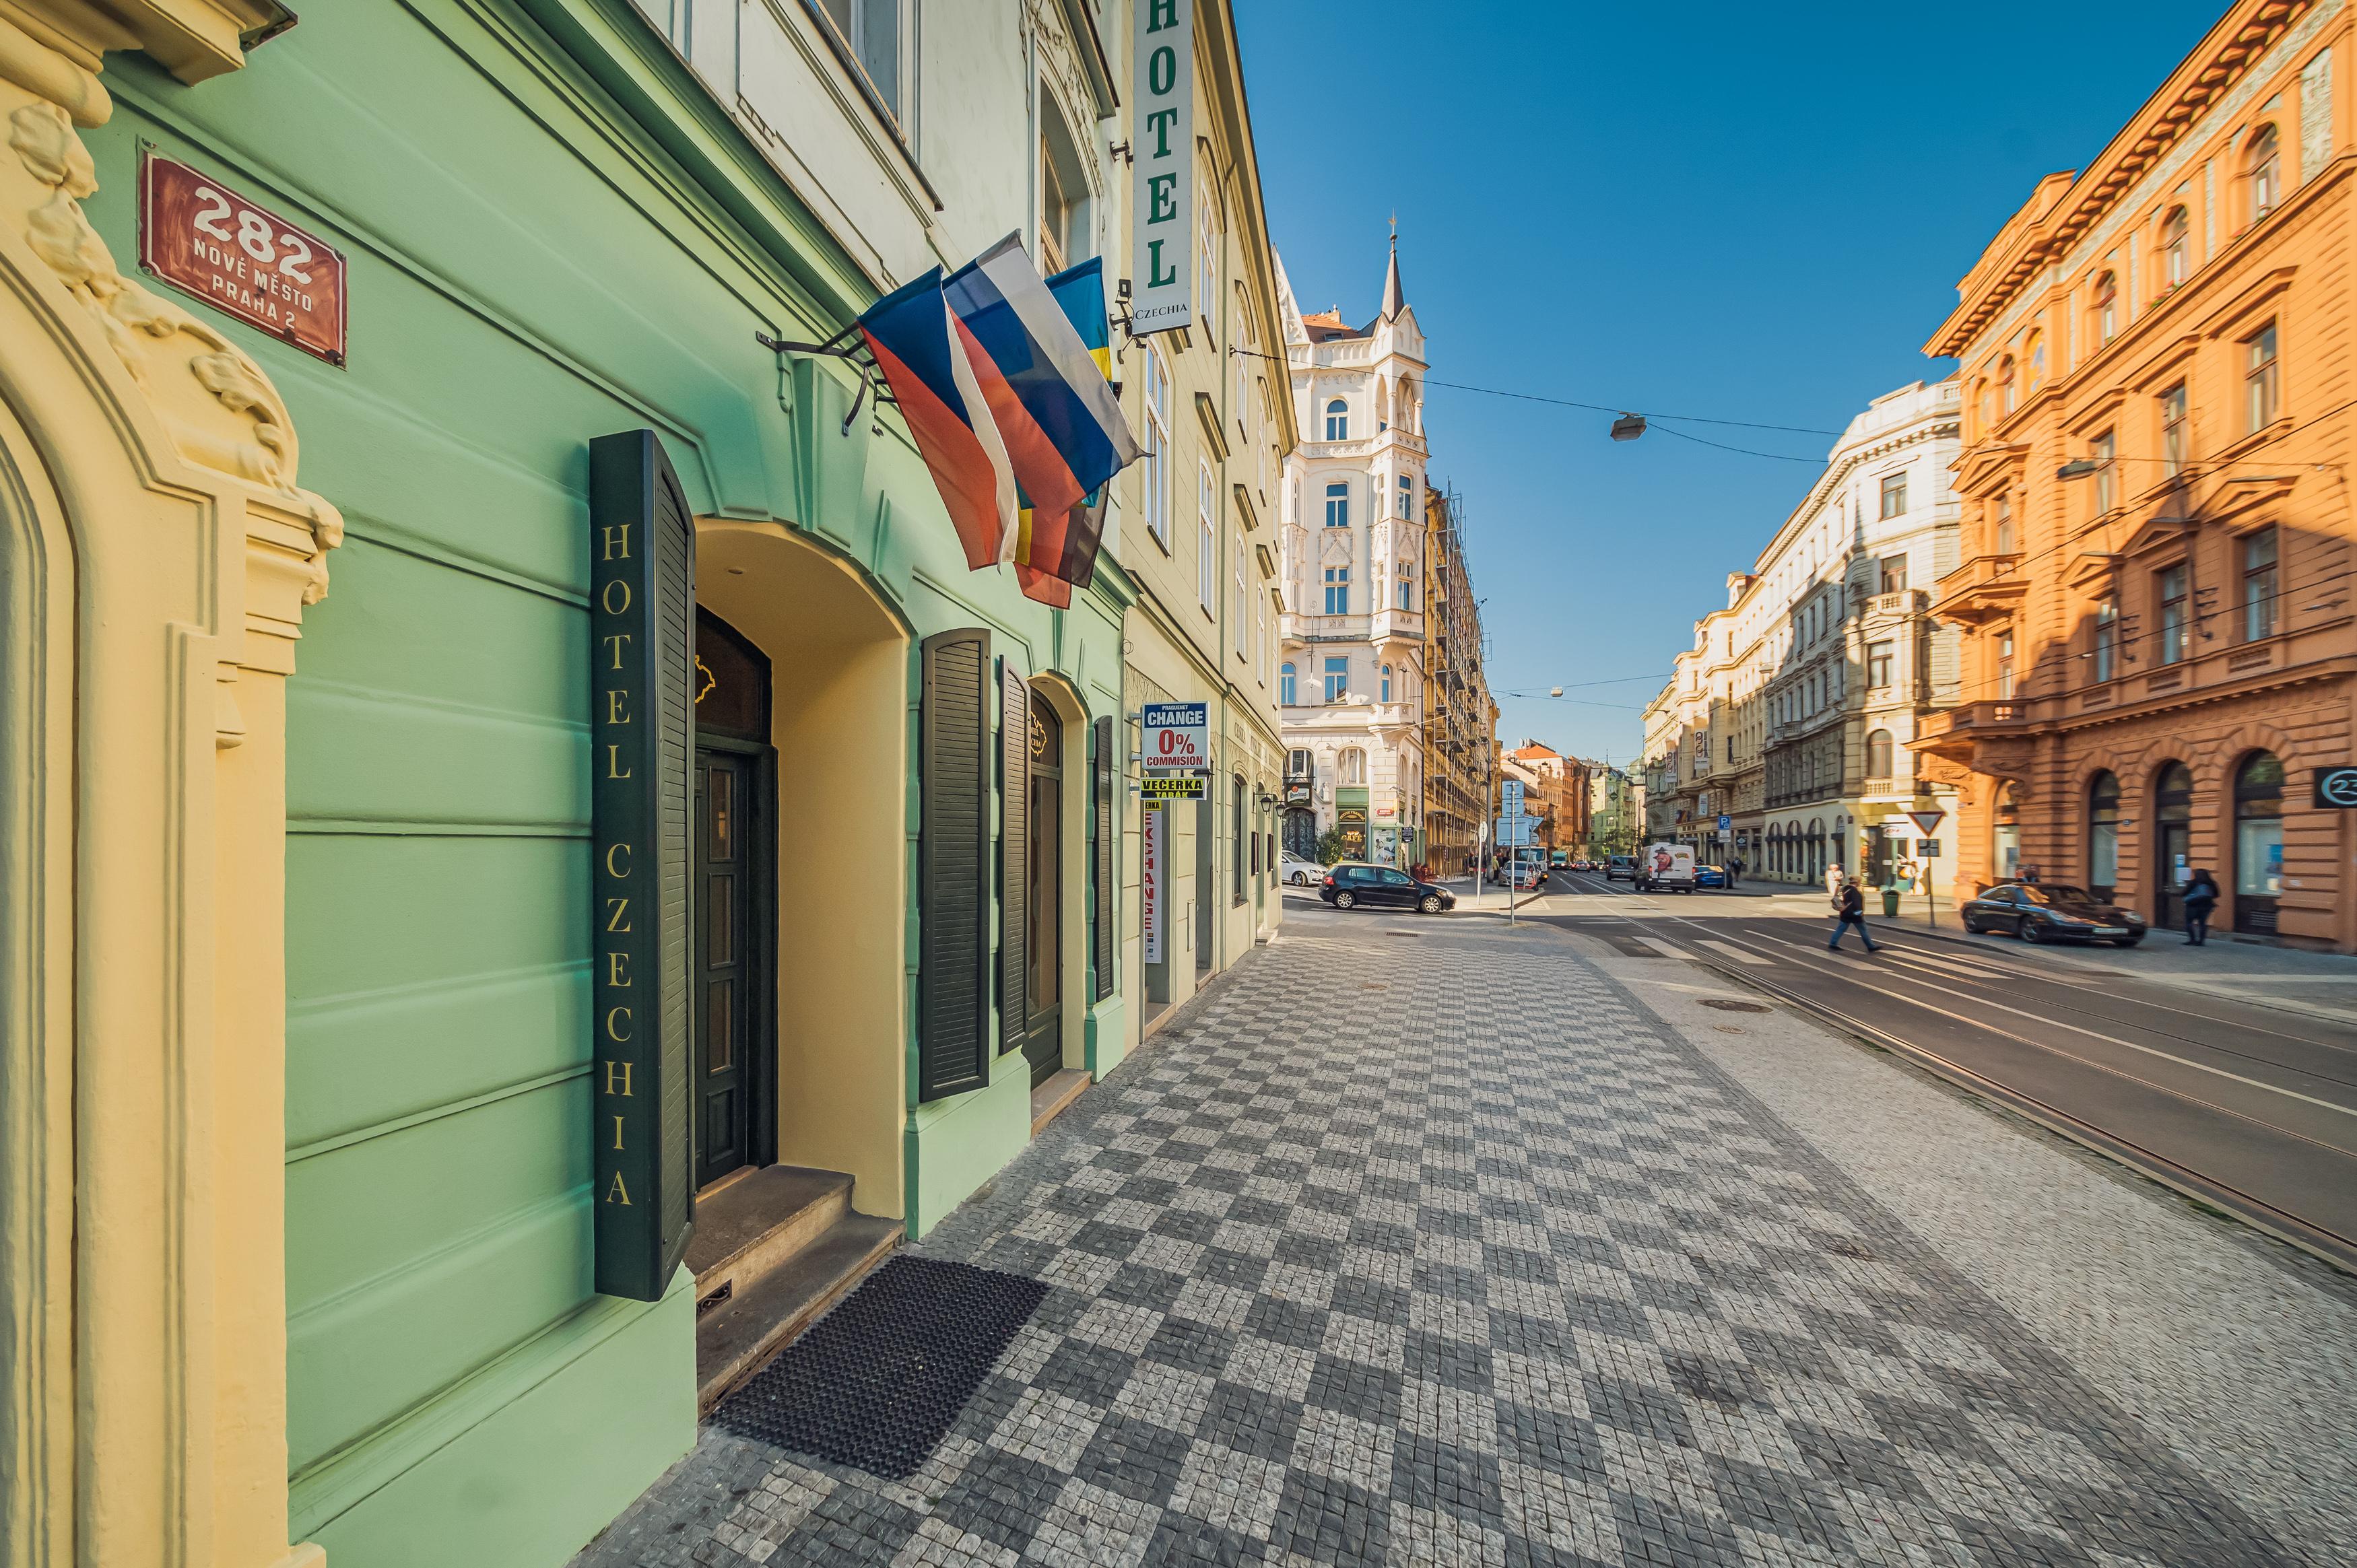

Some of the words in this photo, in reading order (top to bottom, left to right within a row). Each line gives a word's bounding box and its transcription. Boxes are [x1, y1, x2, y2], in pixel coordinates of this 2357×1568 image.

[1146, 0, 1178, 288] HOTEL
[194, 186, 312, 284] 282
[194, 238, 246, 279] NOVÉ
[254, 269, 312, 312] MĚSTO
[211, 273, 277, 320] PRAHA
[285, 310, 295, 329] 2
[1135, 303, 1187, 320] CZECHIA
[602, 523, 631, 779] HOTEL
[1148, 711, 1203, 726] CHANGE
[1159, 729, 1195, 755] 0%
[1142, 779, 1203, 790] VEČERKA
[1147, 756, 1203, 766] COMMISION
[605, 843, 634, 1206] CZECHIA
